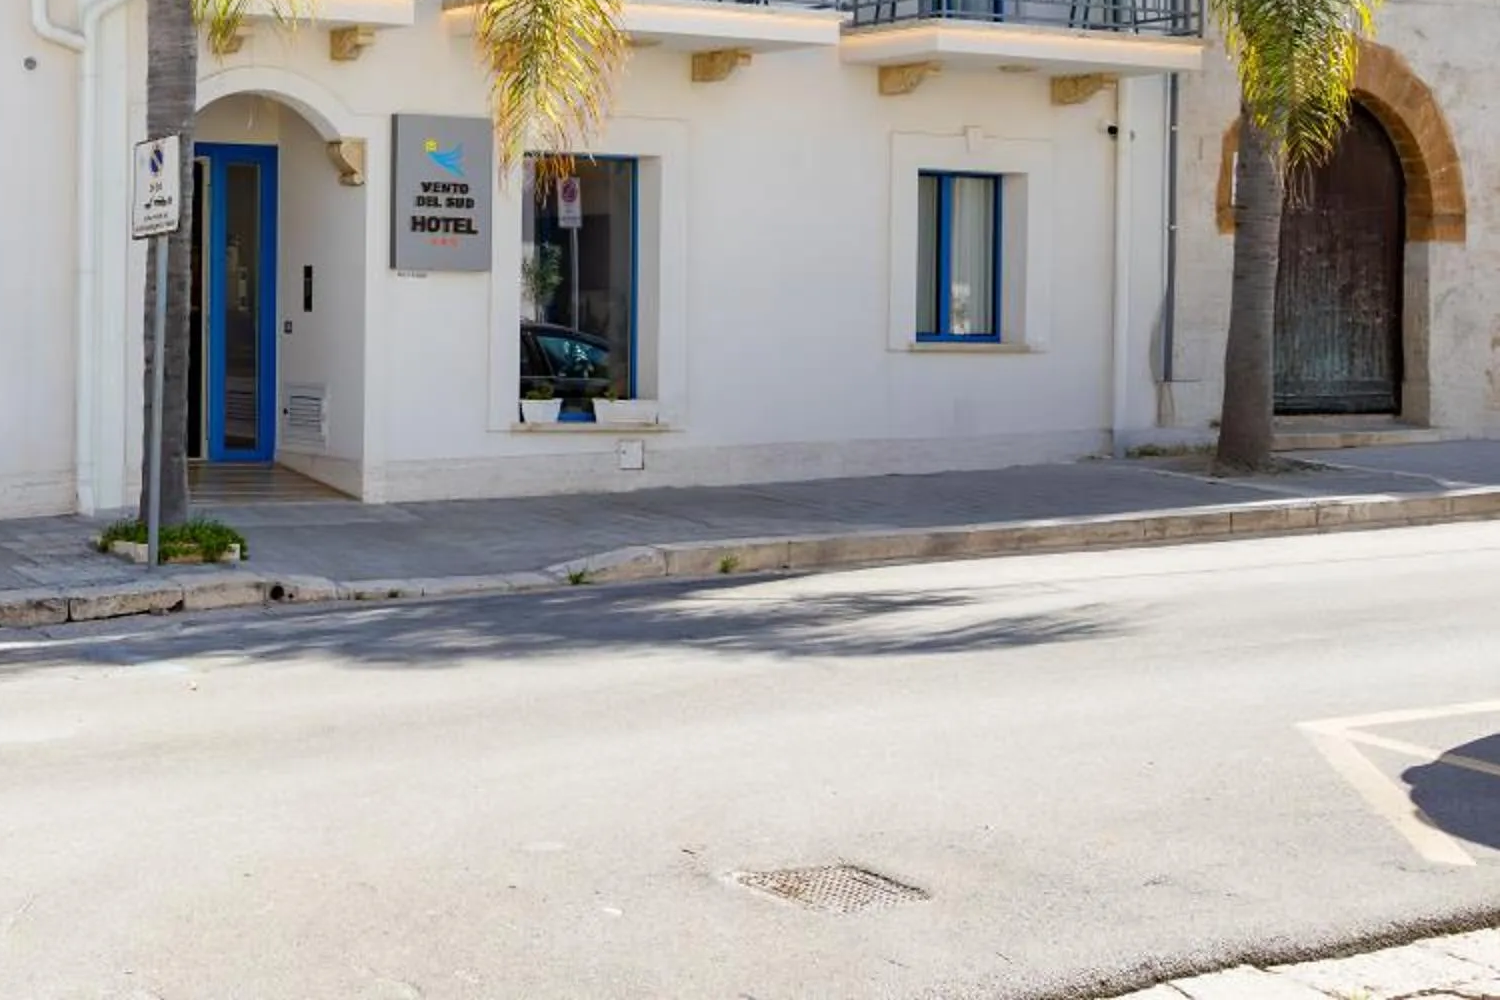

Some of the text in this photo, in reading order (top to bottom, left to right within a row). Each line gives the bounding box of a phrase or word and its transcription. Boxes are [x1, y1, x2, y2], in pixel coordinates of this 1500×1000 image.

[420, 181, 469, 195] VENTO
[416, 195, 475, 209] DEL SUD
[410, 216, 479, 236] HOTEL
